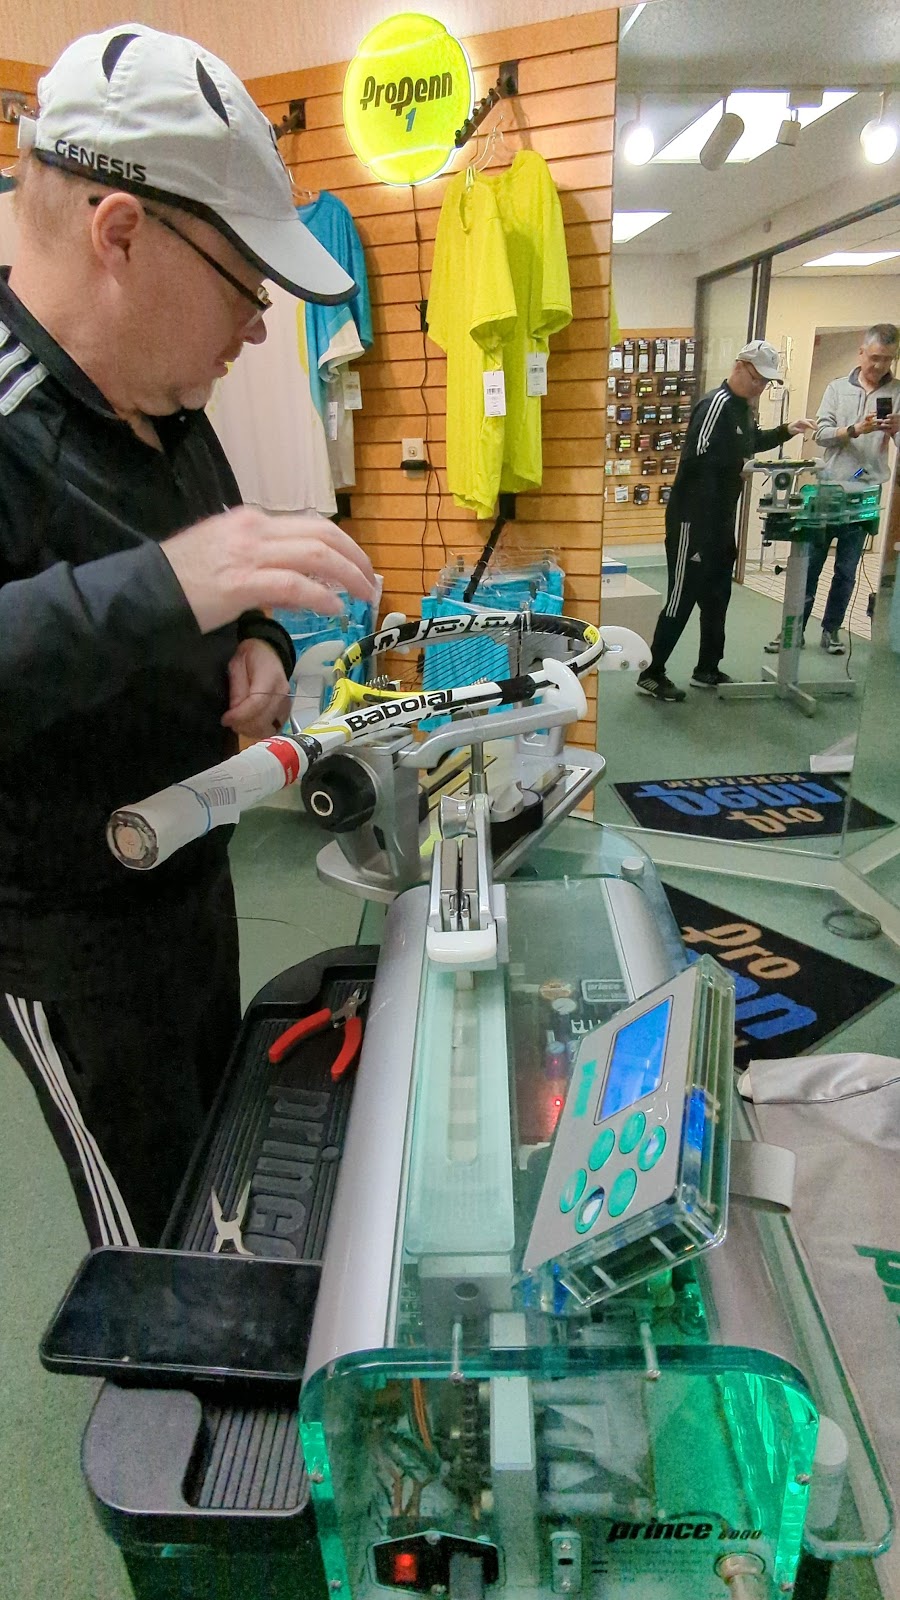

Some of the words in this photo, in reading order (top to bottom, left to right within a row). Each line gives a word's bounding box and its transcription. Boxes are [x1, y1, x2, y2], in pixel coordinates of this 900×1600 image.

[405, 107, 417, 132] 1
[55, 139, 147, 182] GENESIS
[606, 1518, 713, 1543] prince
